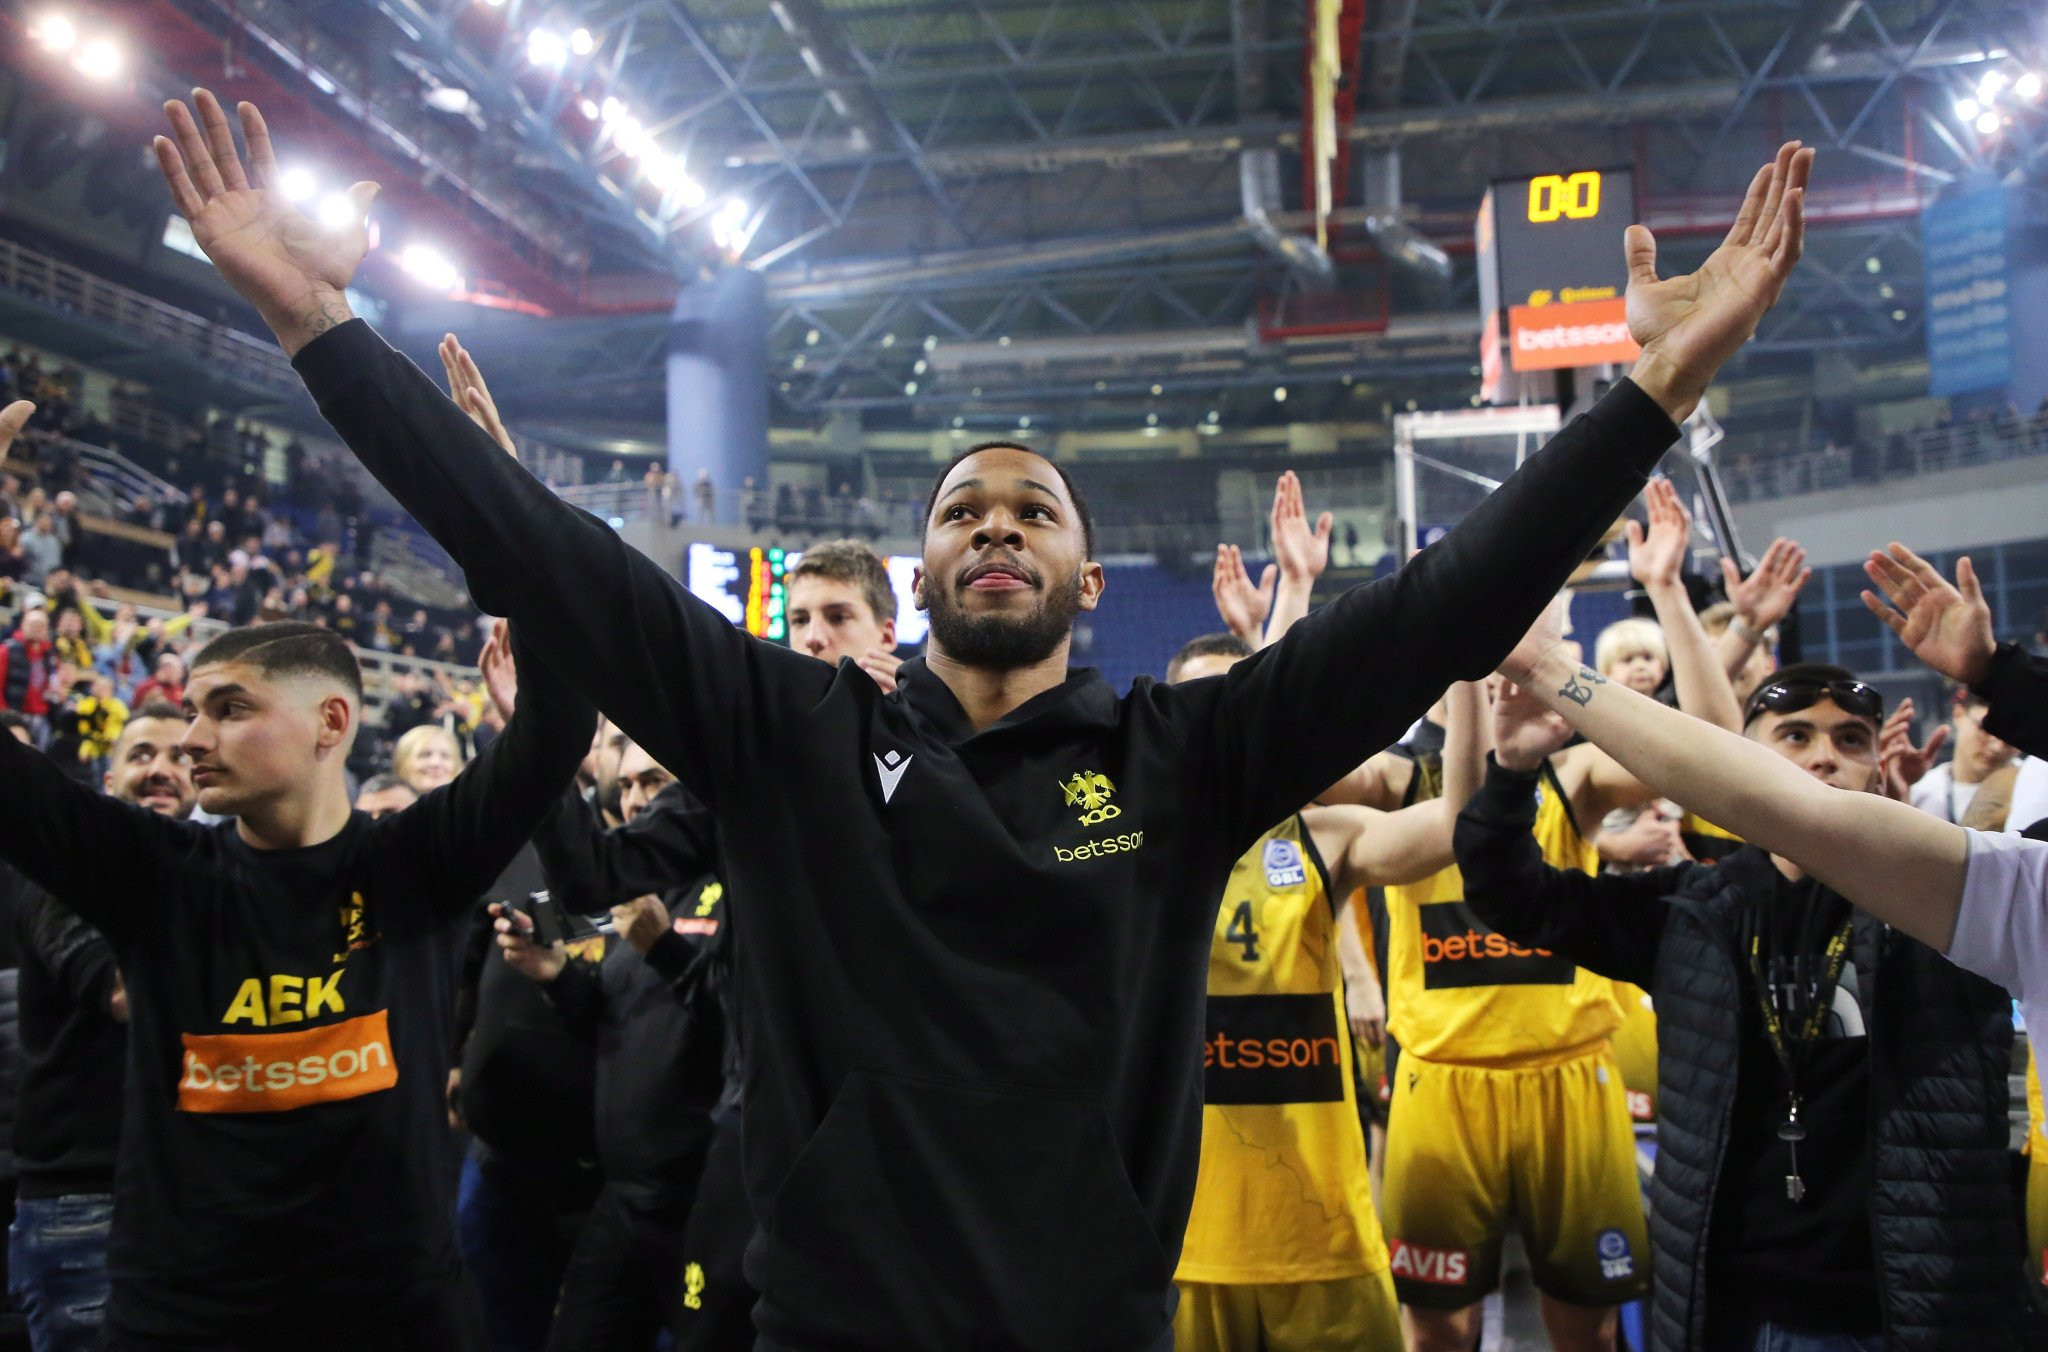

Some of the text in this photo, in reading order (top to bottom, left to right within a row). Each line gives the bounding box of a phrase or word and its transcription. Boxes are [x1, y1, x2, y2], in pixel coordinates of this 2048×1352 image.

[1226, 900, 1260, 962] 4
[221, 968, 346, 1027] AEK
[184, 1041, 389, 1093] betsson
[1392, 1245, 1467, 1281] AVIS
